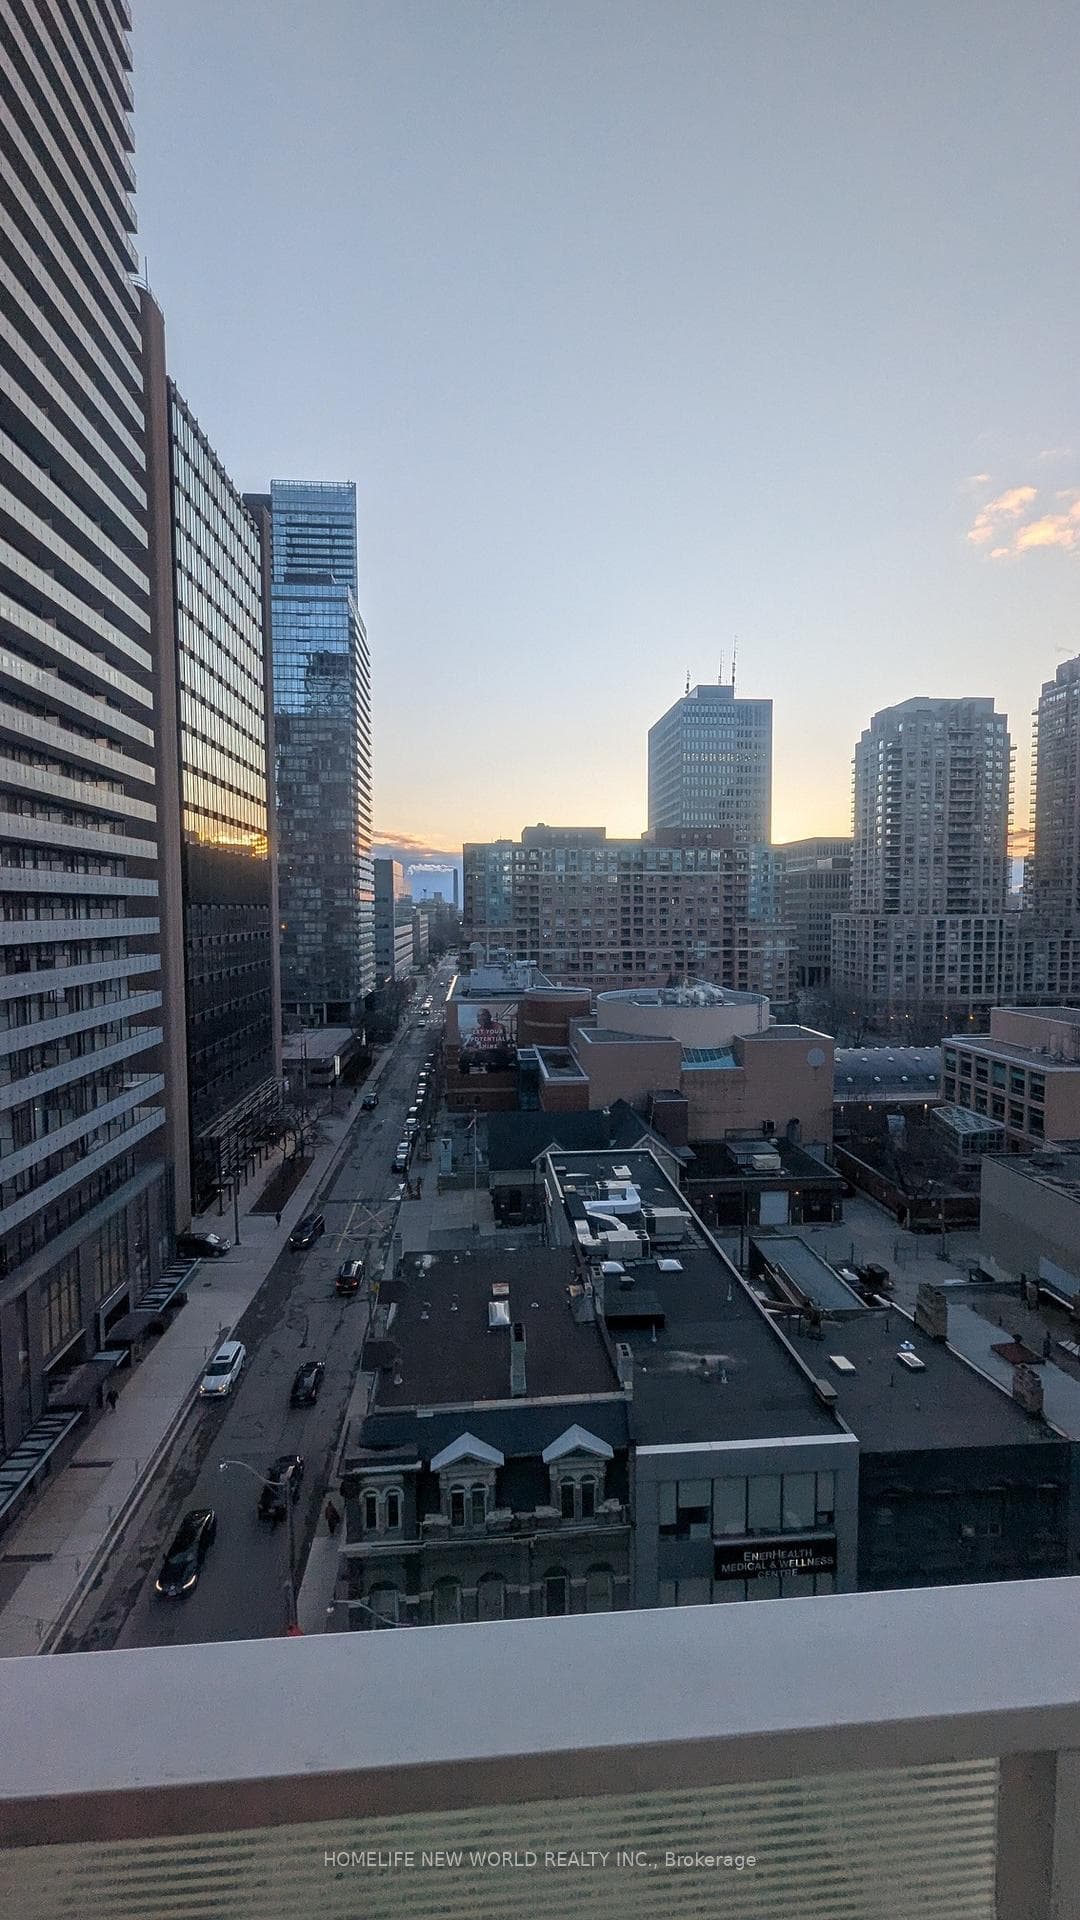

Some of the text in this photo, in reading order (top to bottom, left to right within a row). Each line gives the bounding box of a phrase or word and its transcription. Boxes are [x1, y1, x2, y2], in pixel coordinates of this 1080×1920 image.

[721, 1556, 834, 1573] MEDICAL & WELLNESS
[757, 1568, 798, 1578] CENTRE
